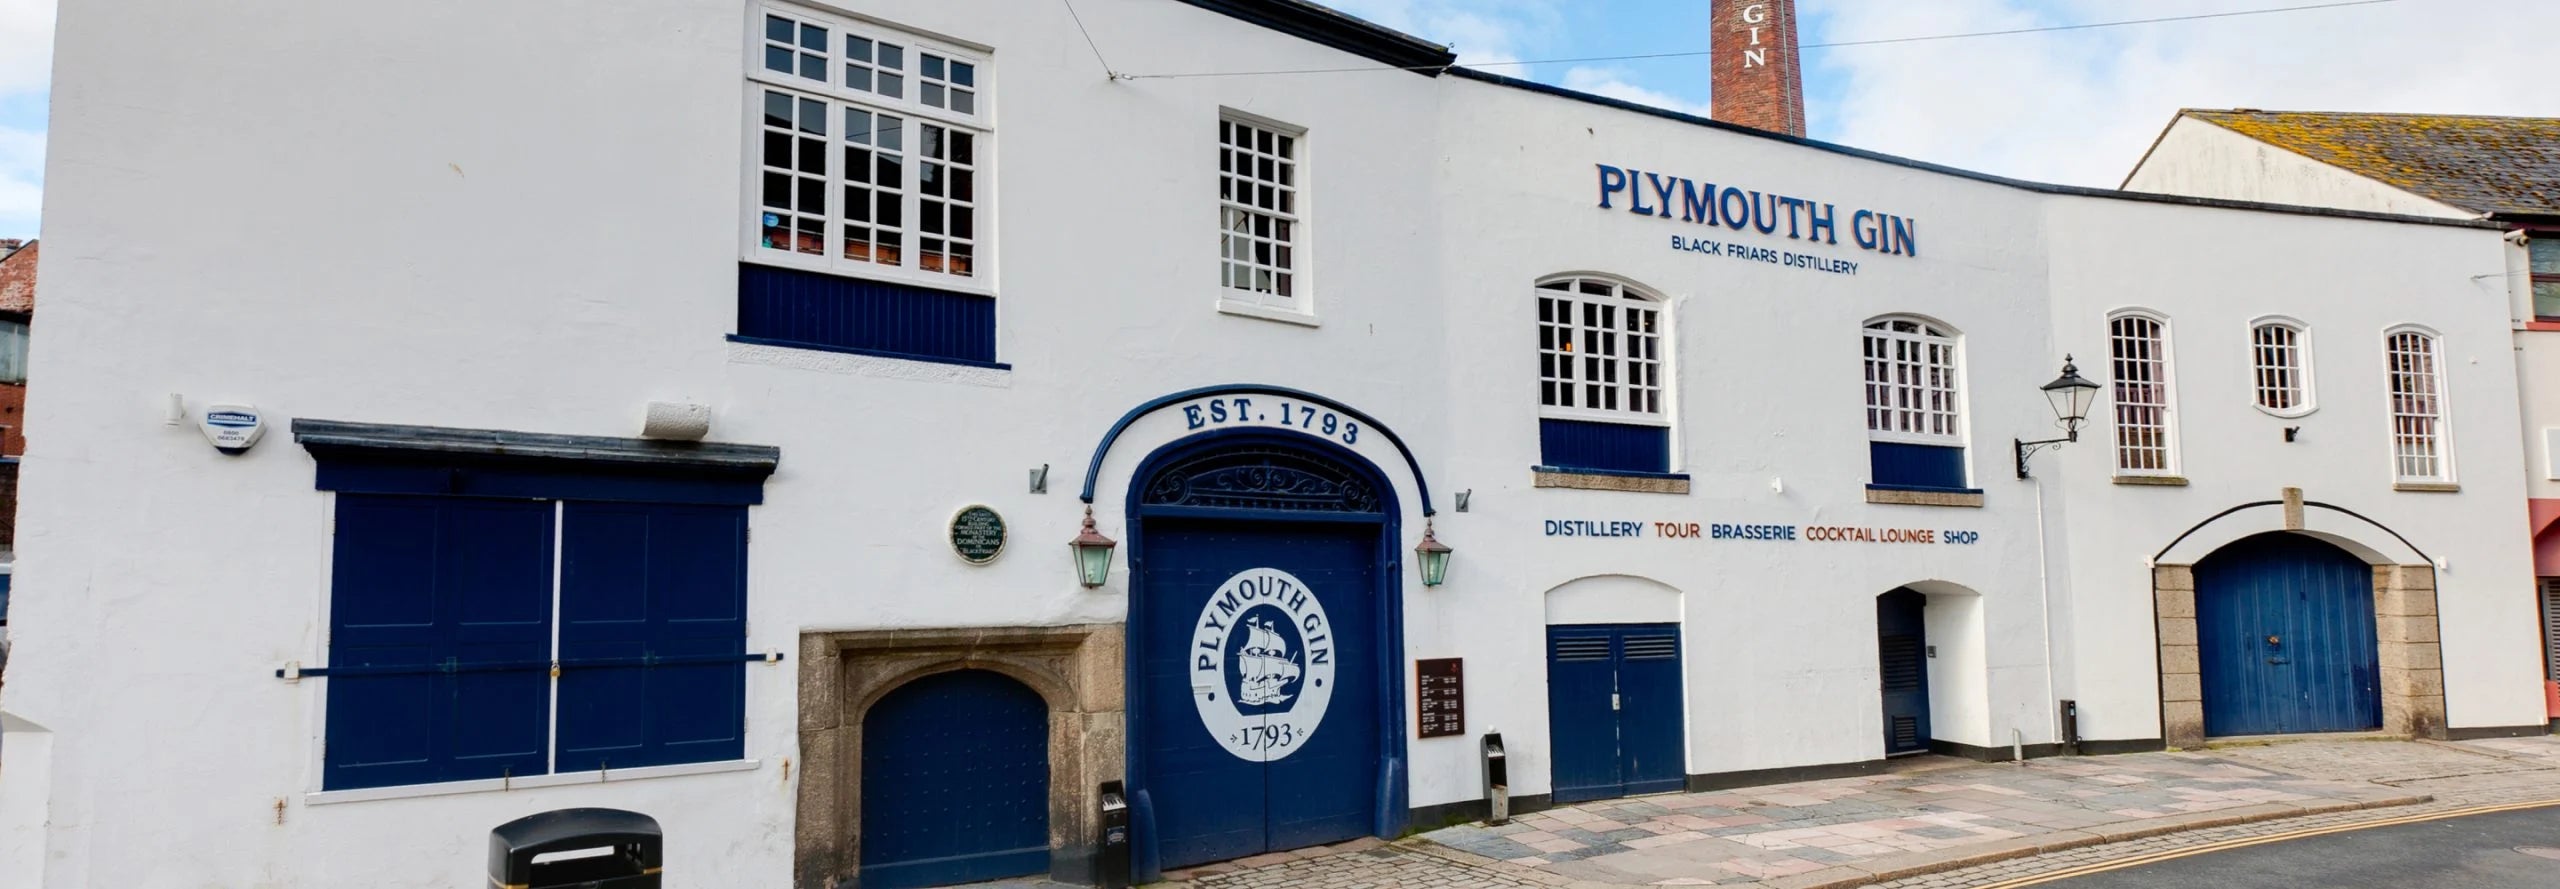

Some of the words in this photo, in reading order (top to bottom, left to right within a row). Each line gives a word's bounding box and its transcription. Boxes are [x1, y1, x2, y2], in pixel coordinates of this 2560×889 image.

[1743, 4, 1767, 69] GIN
[1595, 163, 1838, 246] PLYMOUTH
[1851, 209, 1916, 258] GIN
[1672, 235, 1722, 257] BLACK
[1727, 243, 1778, 265] FRIARS
[1783, 252, 1859, 276] DISTILLERY
[210, 414, 254, 422] CRIMEHALT
[1183, 398, 1265, 430] EST.
[1280, 403, 1359, 445] 1793
[1544, 519, 1643, 537] DISTILLERY
[1654, 521, 1701, 539] TOUR
[1711, 523, 1796, 541] BRASSERIE
[1805, 526, 1876, 543] COCKTAIL
[1879, 528, 1936, 544] LOUNGE
[1943, 529, 1979, 545] SHOP
[1198, 576, 1308, 672] PLYMOUTH
[1303, 613, 1329, 667] GIN
[1240, 723, 1292, 750] 1793
